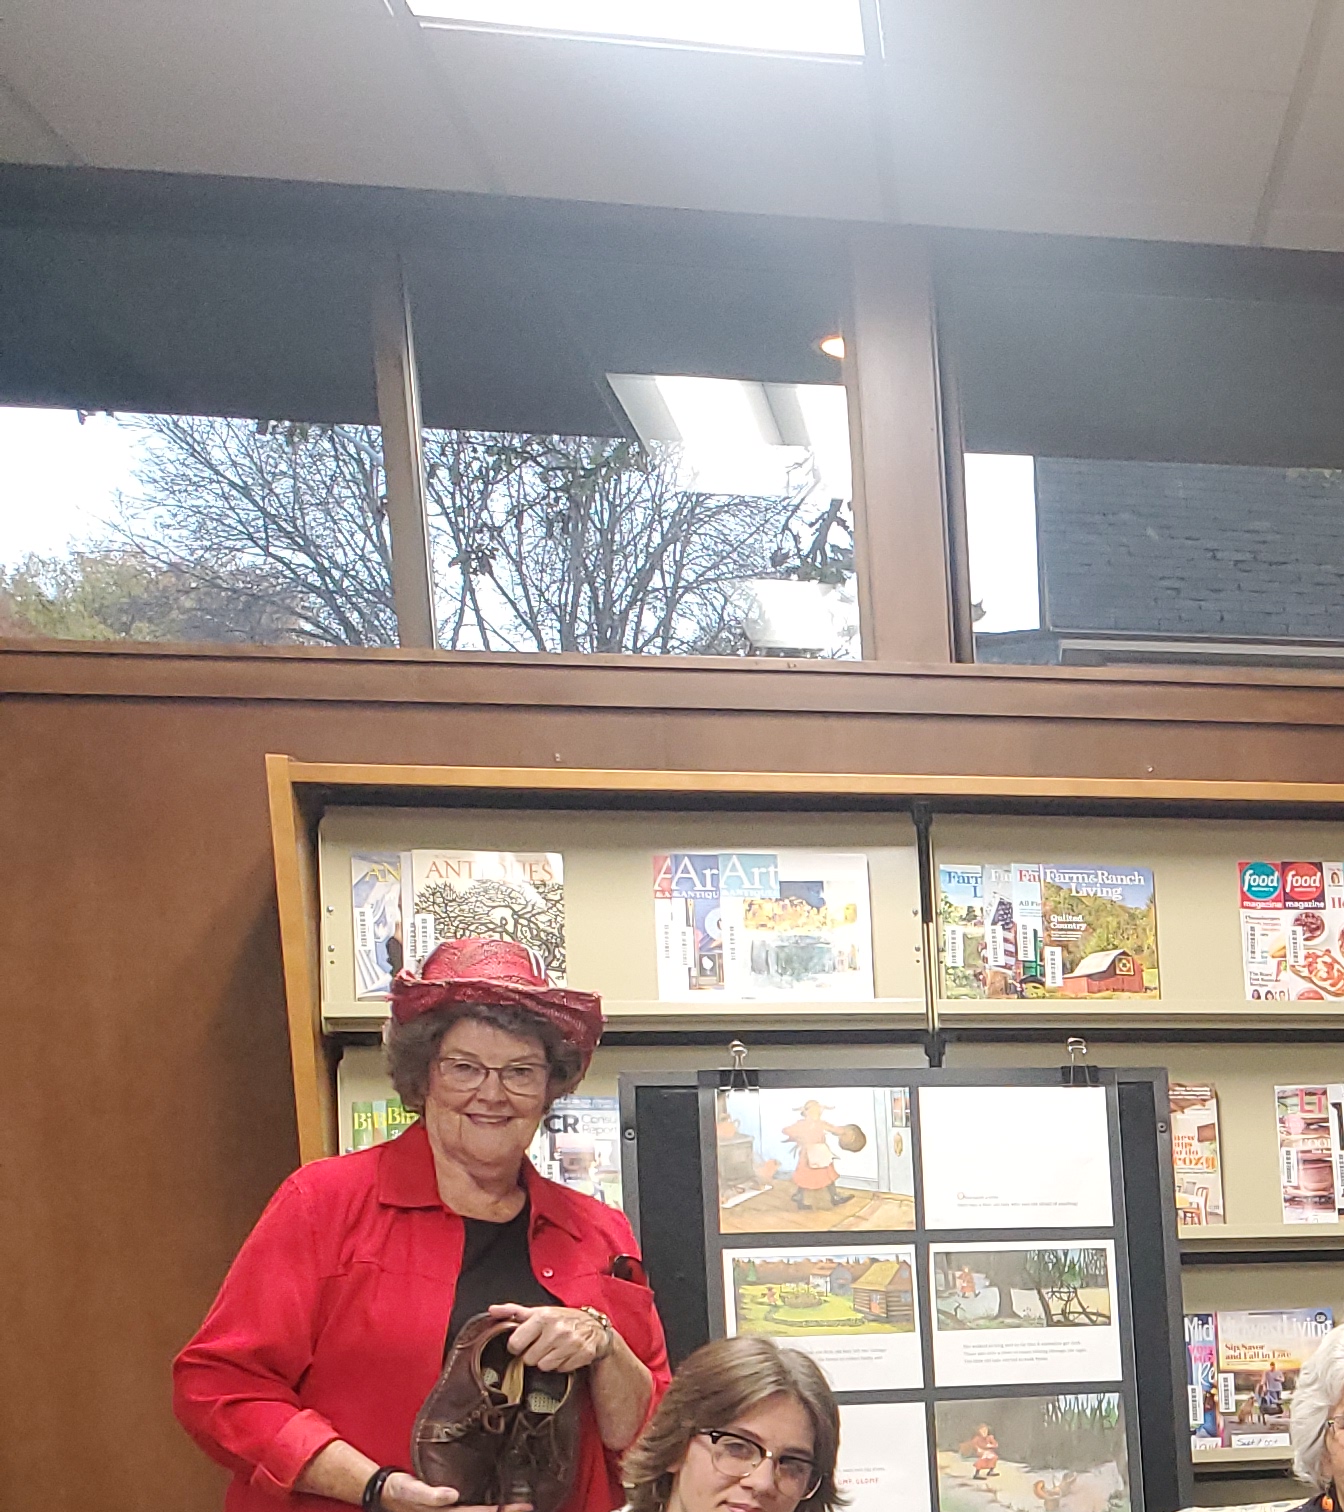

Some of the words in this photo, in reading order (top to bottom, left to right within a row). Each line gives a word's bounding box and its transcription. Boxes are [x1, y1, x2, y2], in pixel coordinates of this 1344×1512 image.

[425, 860, 555, 882] ANTES
[719, 854, 780, 891] Art
[1243, 866, 1279, 892] food
[1286, 866, 1322, 892] food
[1070, 885, 1123, 901] Living
[1243, 900, 1283, 909] magazine
[1285, 900, 1325, 909] magazine
[1050, 922, 1087, 931] Country
[544, 1114, 580, 1135] CR
